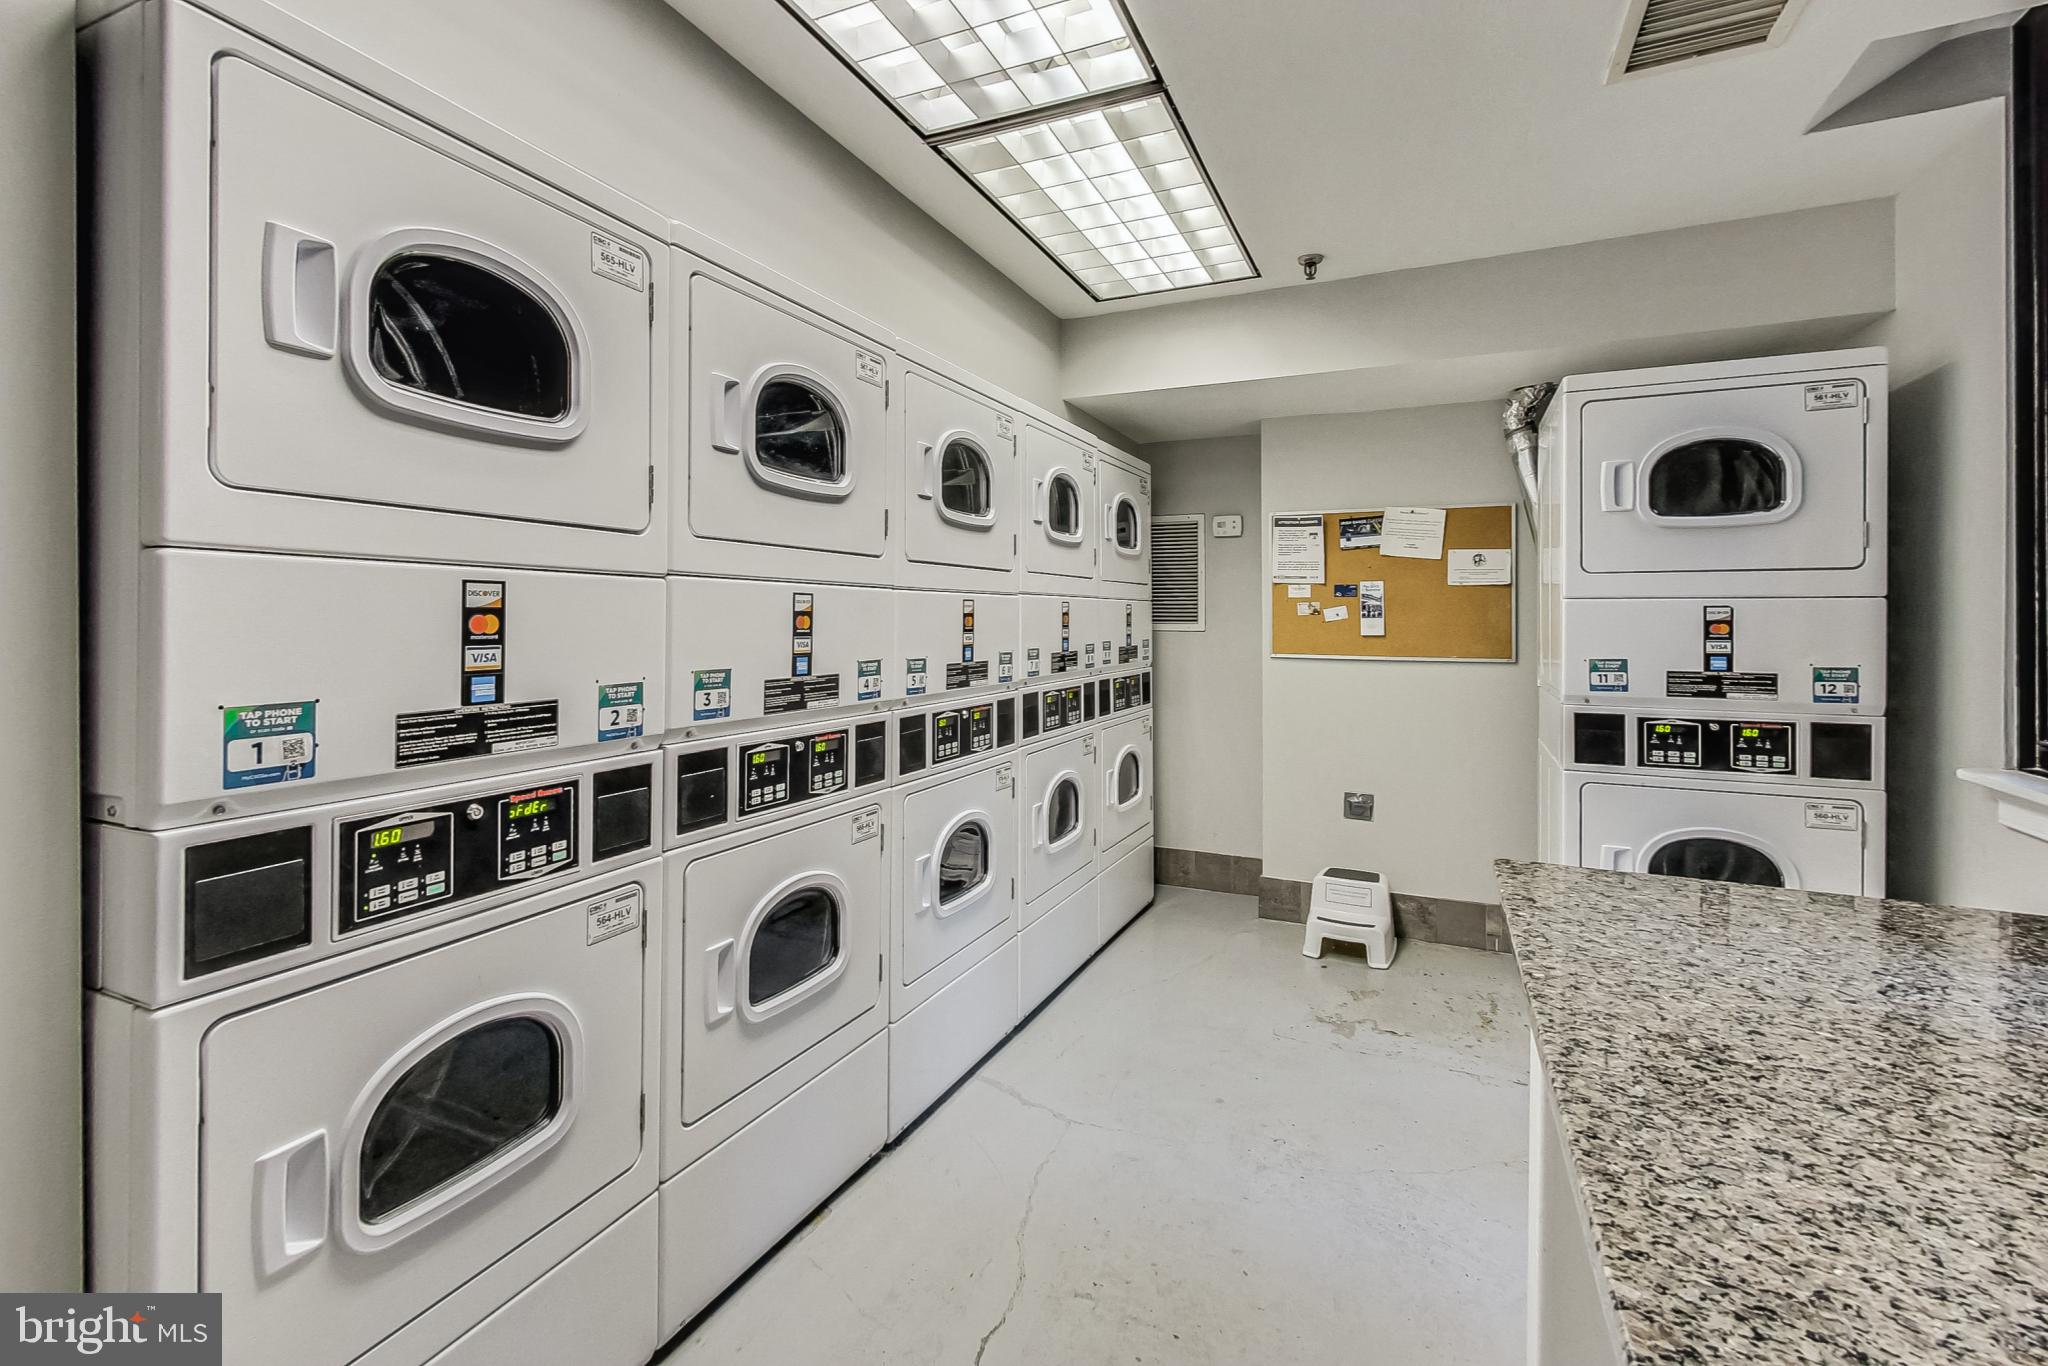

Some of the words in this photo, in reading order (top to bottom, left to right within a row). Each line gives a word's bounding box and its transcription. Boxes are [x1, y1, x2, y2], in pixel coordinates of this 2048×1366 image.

[600, 251, 636, 273] 565-HLV
[467, 589, 500, 597] DISCOVER
[471, 652, 497, 663] VISA
[864, 678, 870, 690] 4
[911, 675, 917, 686] 5
[1597, 673, 1608, 683] 11
[1820, 683, 1837, 694] 12
[703, 692, 711, 706] 3
[239, 711, 262, 719] TAP
[264, 707, 303, 718] PHONE
[610, 709, 620, 726] 2
[244, 719, 261, 727] TO
[263, 715, 298, 726] START
[251, 741, 263, 764] 1
[596, 906, 632, 927] 564-HLV
